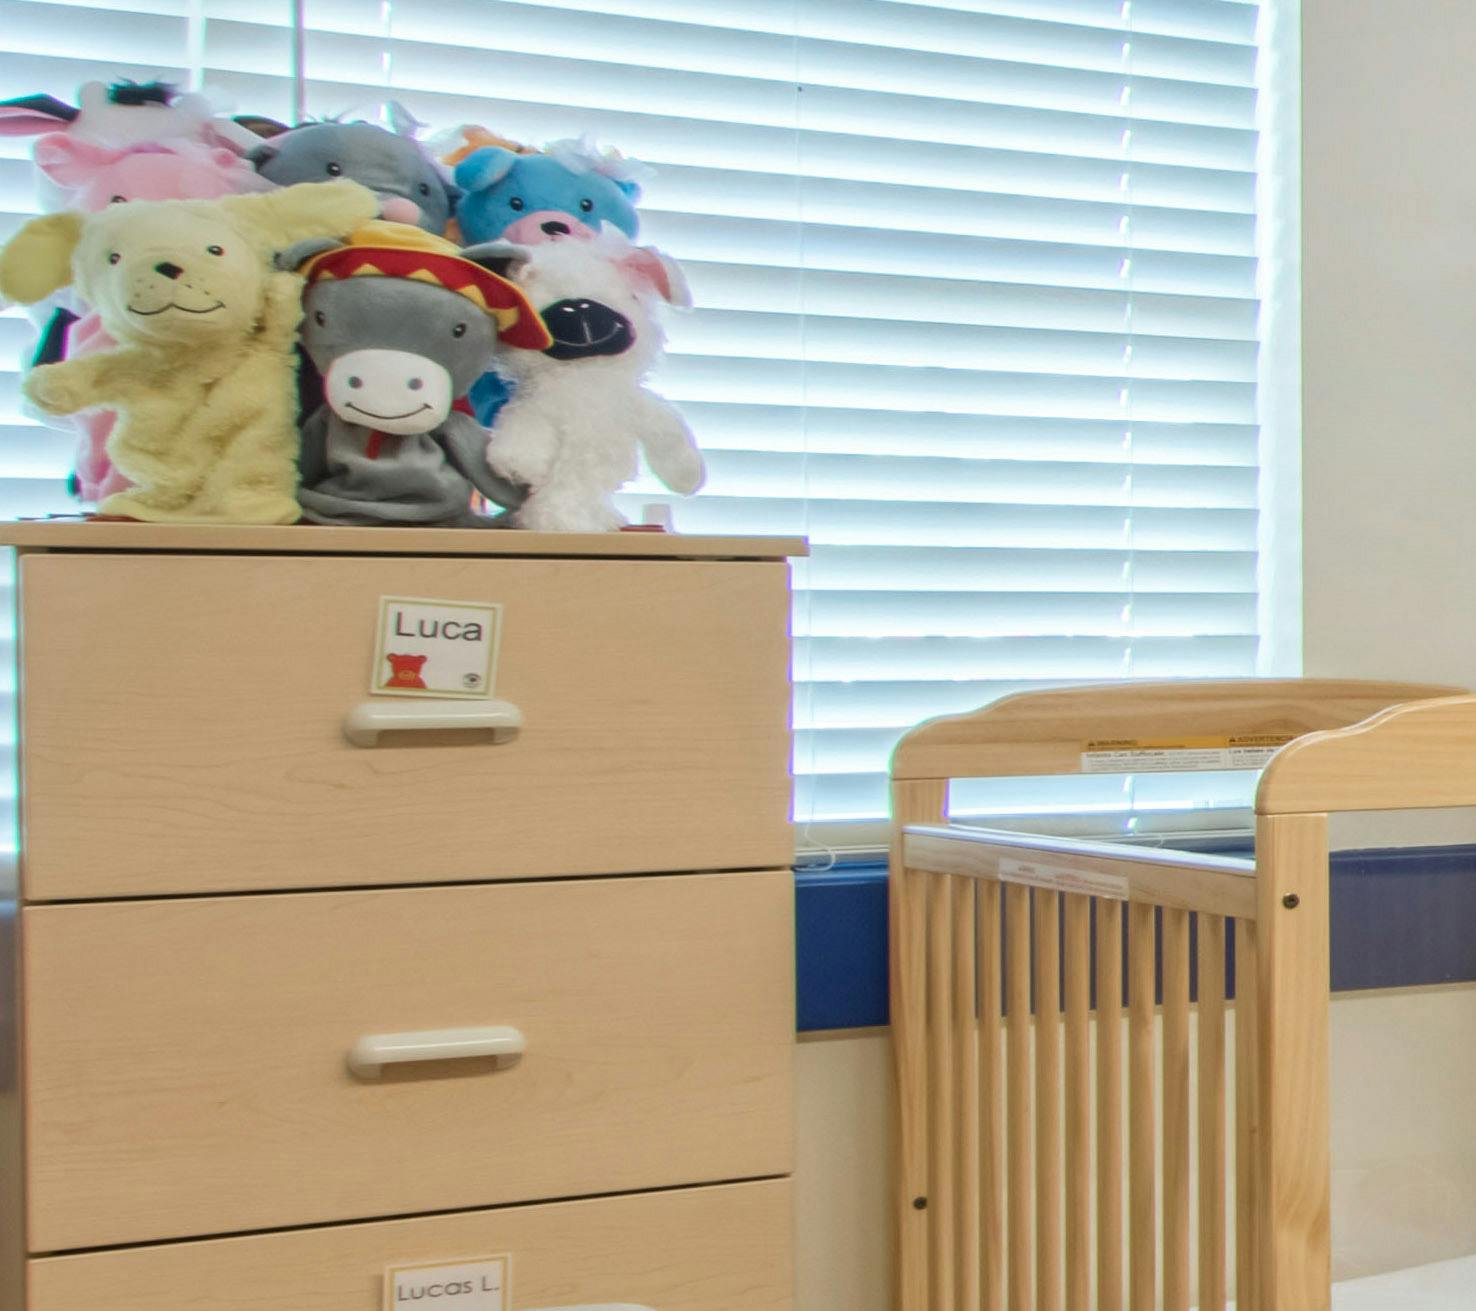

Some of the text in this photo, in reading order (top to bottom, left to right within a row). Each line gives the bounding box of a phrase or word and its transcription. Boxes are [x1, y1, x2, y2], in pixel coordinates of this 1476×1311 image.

[395, 611, 483, 642] Luca
[397, 1275, 500, 1302] Lucas L.
